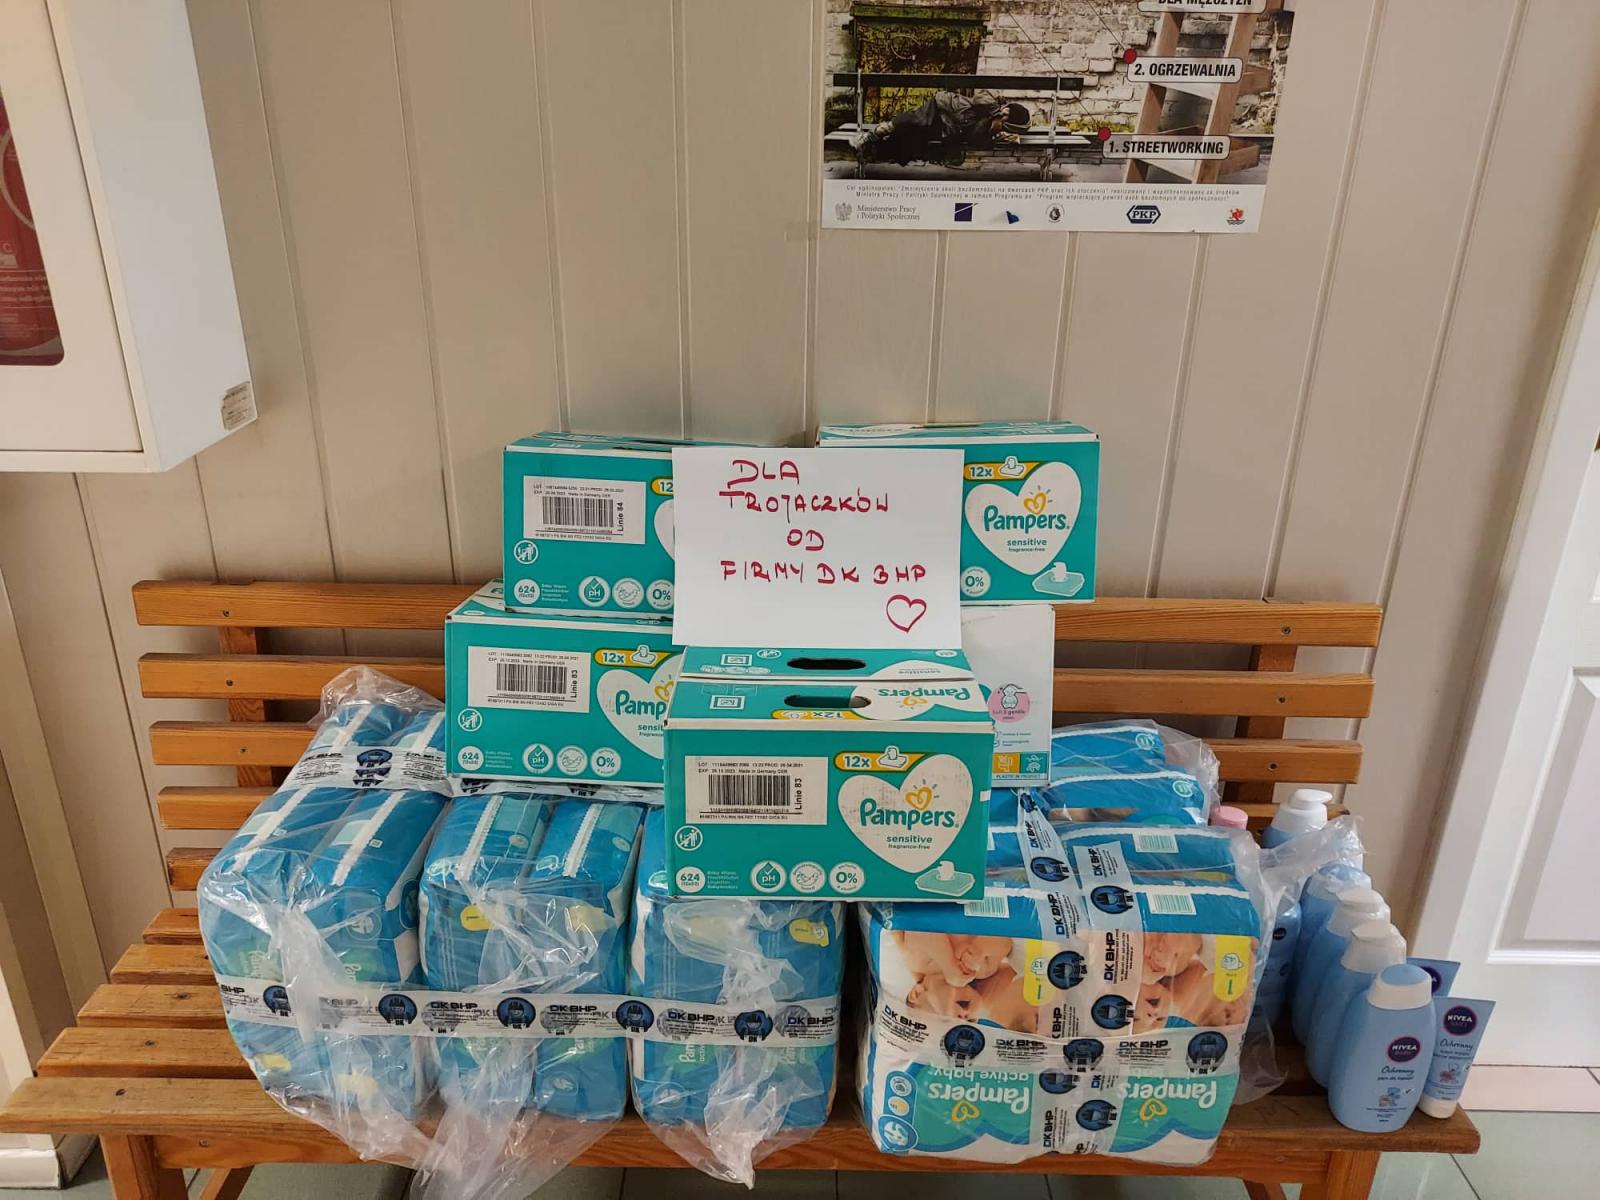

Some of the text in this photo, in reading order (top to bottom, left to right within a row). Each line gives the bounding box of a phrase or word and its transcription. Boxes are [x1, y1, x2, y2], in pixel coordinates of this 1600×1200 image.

[1134, 63, 1236, 77] 2. OGRZEWALNIA
[1109, 141, 1224, 154] 1. STREETWORKING
[856, 204, 916, 214] Ministerstwo Pracy
[1131, 210, 1157, 220] PKP
[861, 212, 885, 221] Polityki
[886, 212, 921, 222] Społecznej
[727, 459, 801, 489] DLA
[969, 466, 993, 478] 12x
[660, 482, 673, 492] 12
[983, 504, 1067, 534] Pampers
[786, 528, 825, 552] OD
[1007, 538, 1048, 547] sensitive
[720, 560, 927, 585] FIRMY DK BHP
[965, 576, 985, 588] 0%
[518, 585, 536, 594] 624
[588, 590, 600, 598] pH
[652, 588, 672, 600] 0%
[602, 652, 624, 664] 12x
[570, 680, 578, 699] Linie
[877, 687, 972, 701] Pampers
[615, 690, 666, 720] Pamp
[813, 710, 844, 718] 12x
[637, 723, 664, 732] sensit
[462, 752, 480, 761] 624
[531, 756, 544, 764] pH
[596, 757, 616, 768] 0%
[844, 755, 871, 768] 12x
[859, 798, 956, 831] Pampers
[886, 834, 933, 844] sensitive
[1030, 838, 1039, 848] DK
[1088, 848, 1103, 877] DK BHP
[680, 872, 700, 882] 624
[762, 874, 776, 884] pH
[836, 872, 858, 884] 0%
[1054, 916, 1065, 936] DK
[1104, 932, 1116, 982] DK BHP
[430, 1001, 478, 1010] DK BHP
[550, 1004, 568, 1012] DK
[668, 1012, 715, 1021] DK BHP
[787, 1016, 834, 1025] DK BHP
[884, 1005, 928, 1031] DK BHP
[1052, 1007, 1061, 1028] BHP
[1448, 1014, 1472, 1022] NIVEA
[1120, 1040, 1169, 1048] DK BHP
[1440, 1038, 1474, 1050] Ochronny
[1091, 1074, 1101, 1089] DK
[928, 1082, 1030, 1115] Pampers
[1117, 1080, 1217, 1110] Pampers
[1043, 1110, 1053, 1148] DK BHP
